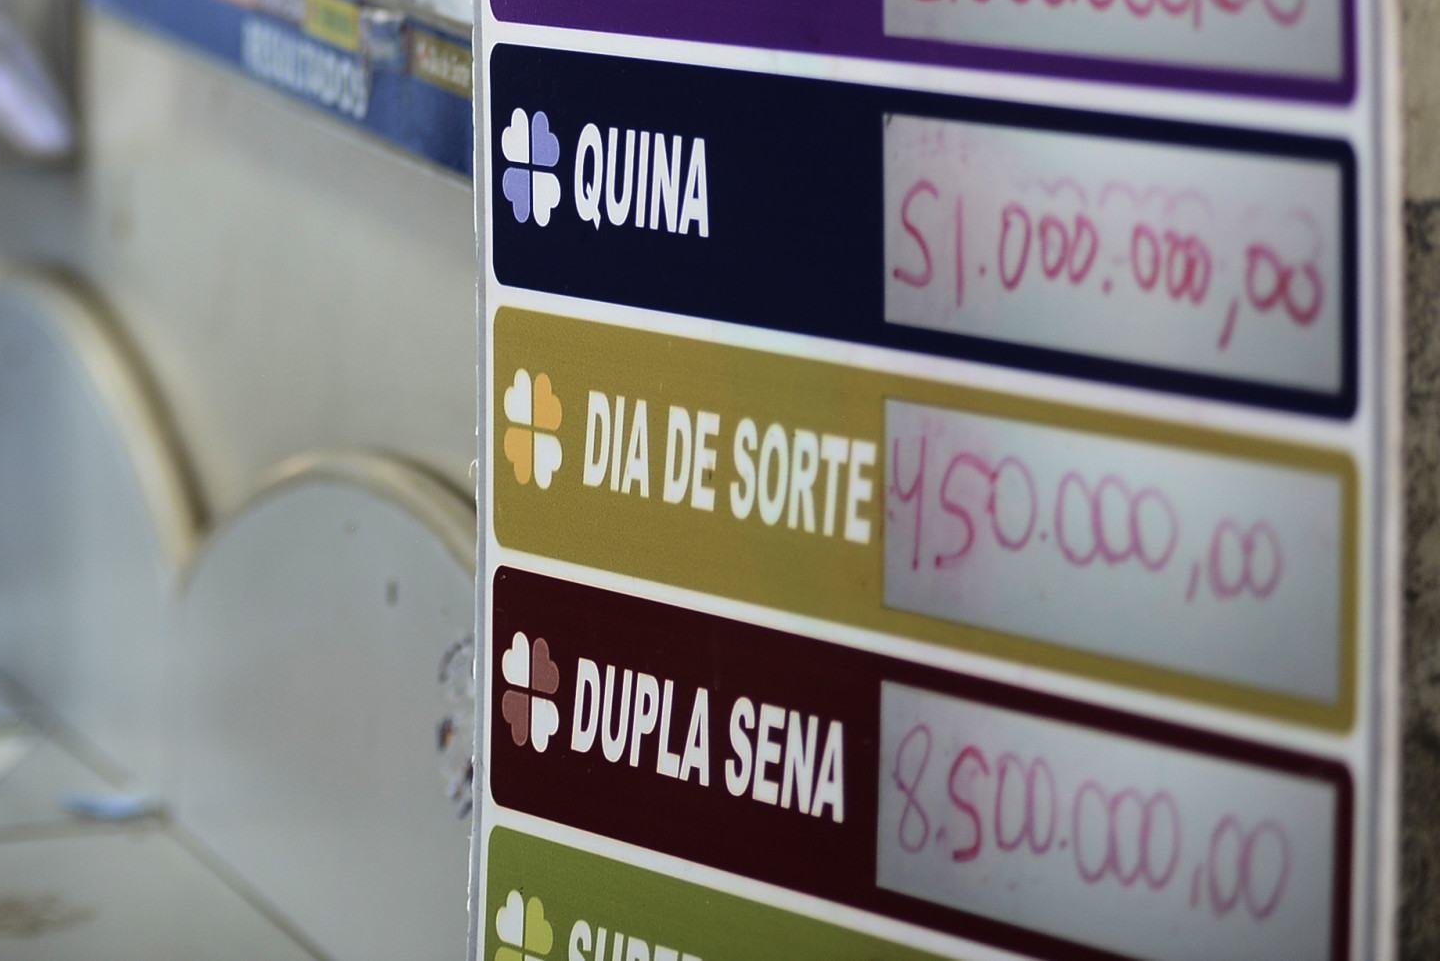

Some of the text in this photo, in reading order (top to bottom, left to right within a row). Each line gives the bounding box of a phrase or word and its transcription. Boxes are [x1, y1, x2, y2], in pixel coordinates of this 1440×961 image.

[574, 122, 709, 238] QUINA
[582, 390, 877, 544] DIA DE SORTE
[570, 657, 844, 823] DUPLA SENA
[892, 723, 1291, 921] 8.500.000,00
